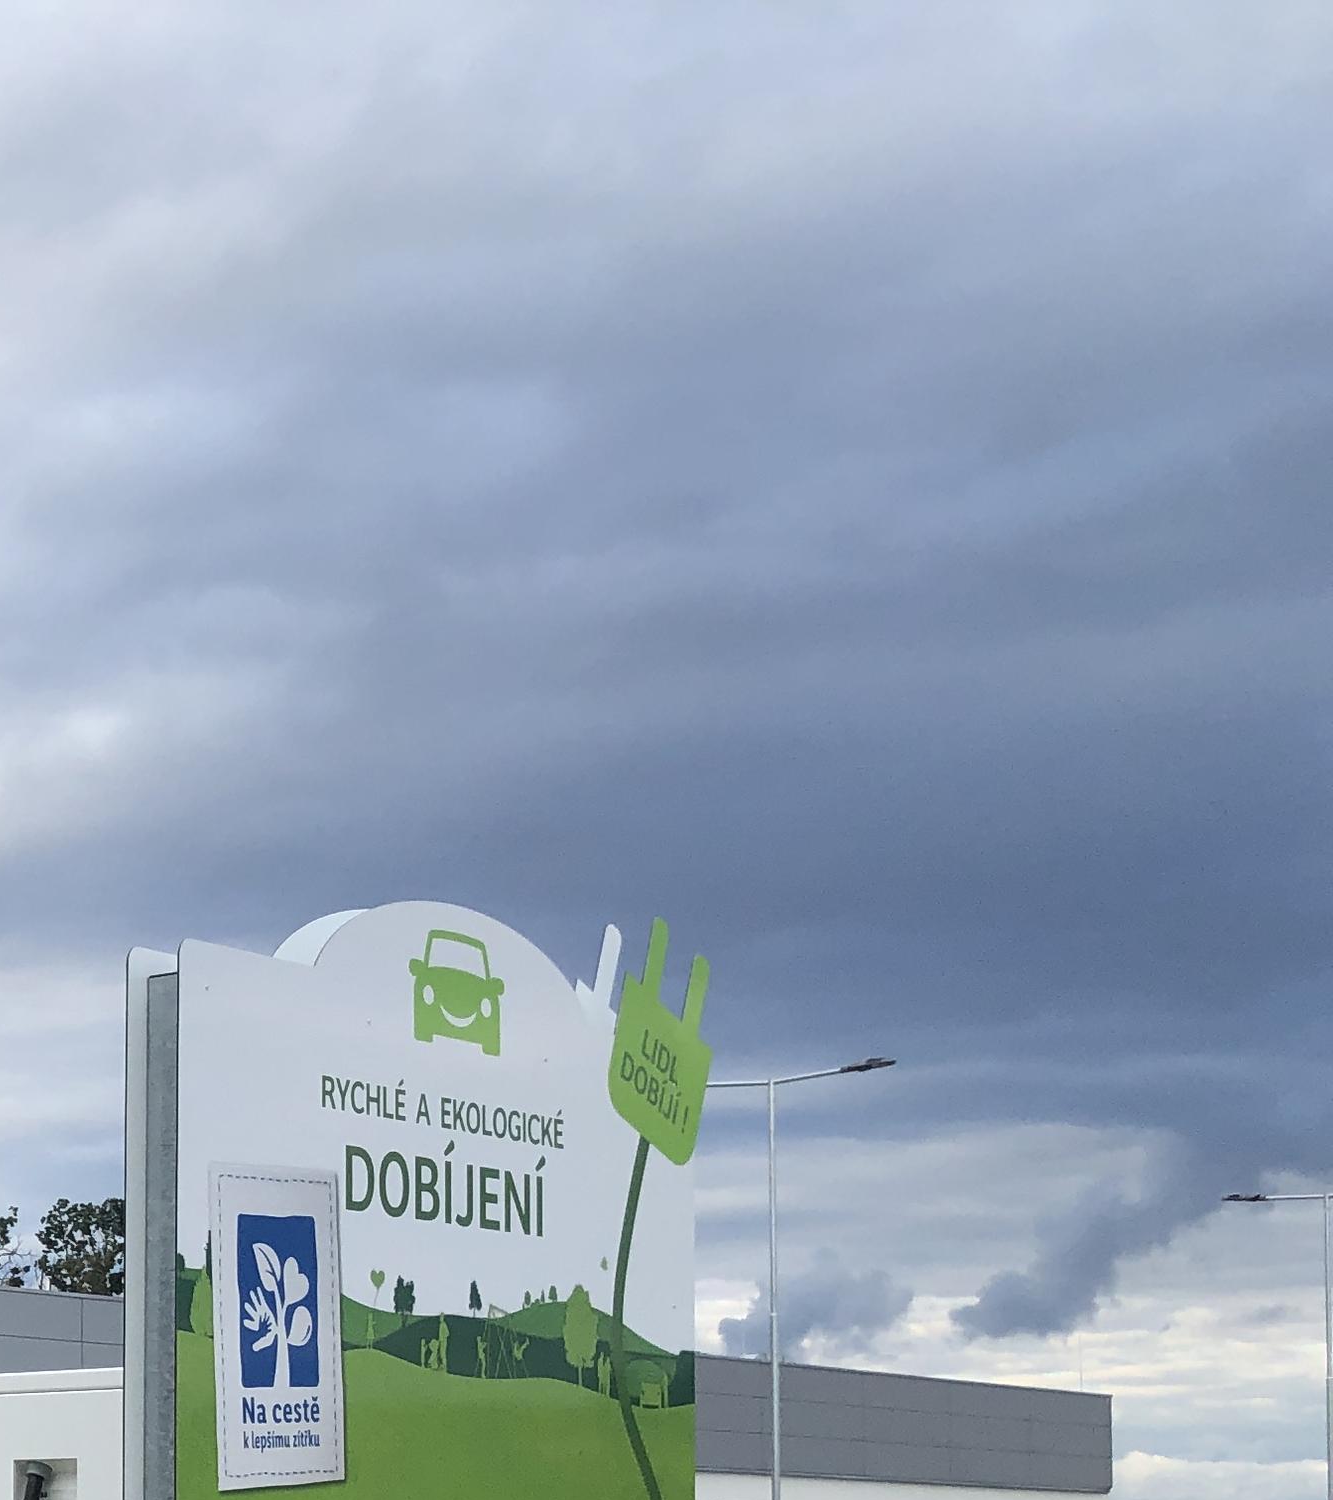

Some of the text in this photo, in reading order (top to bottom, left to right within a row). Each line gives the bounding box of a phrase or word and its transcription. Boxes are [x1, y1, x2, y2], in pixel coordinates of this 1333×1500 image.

[641, 1029, 678, 1086] LIDL
[321, 1074, 565, 1149] RYCHLÉ A EKOLOGICKÉ
[345, 1139, 547, 1237] DOBÍJENÍ
[242, 1396, 320, 1424] Na cestě
[243, 1429, 320, 1453] k lepšímu zítřku
